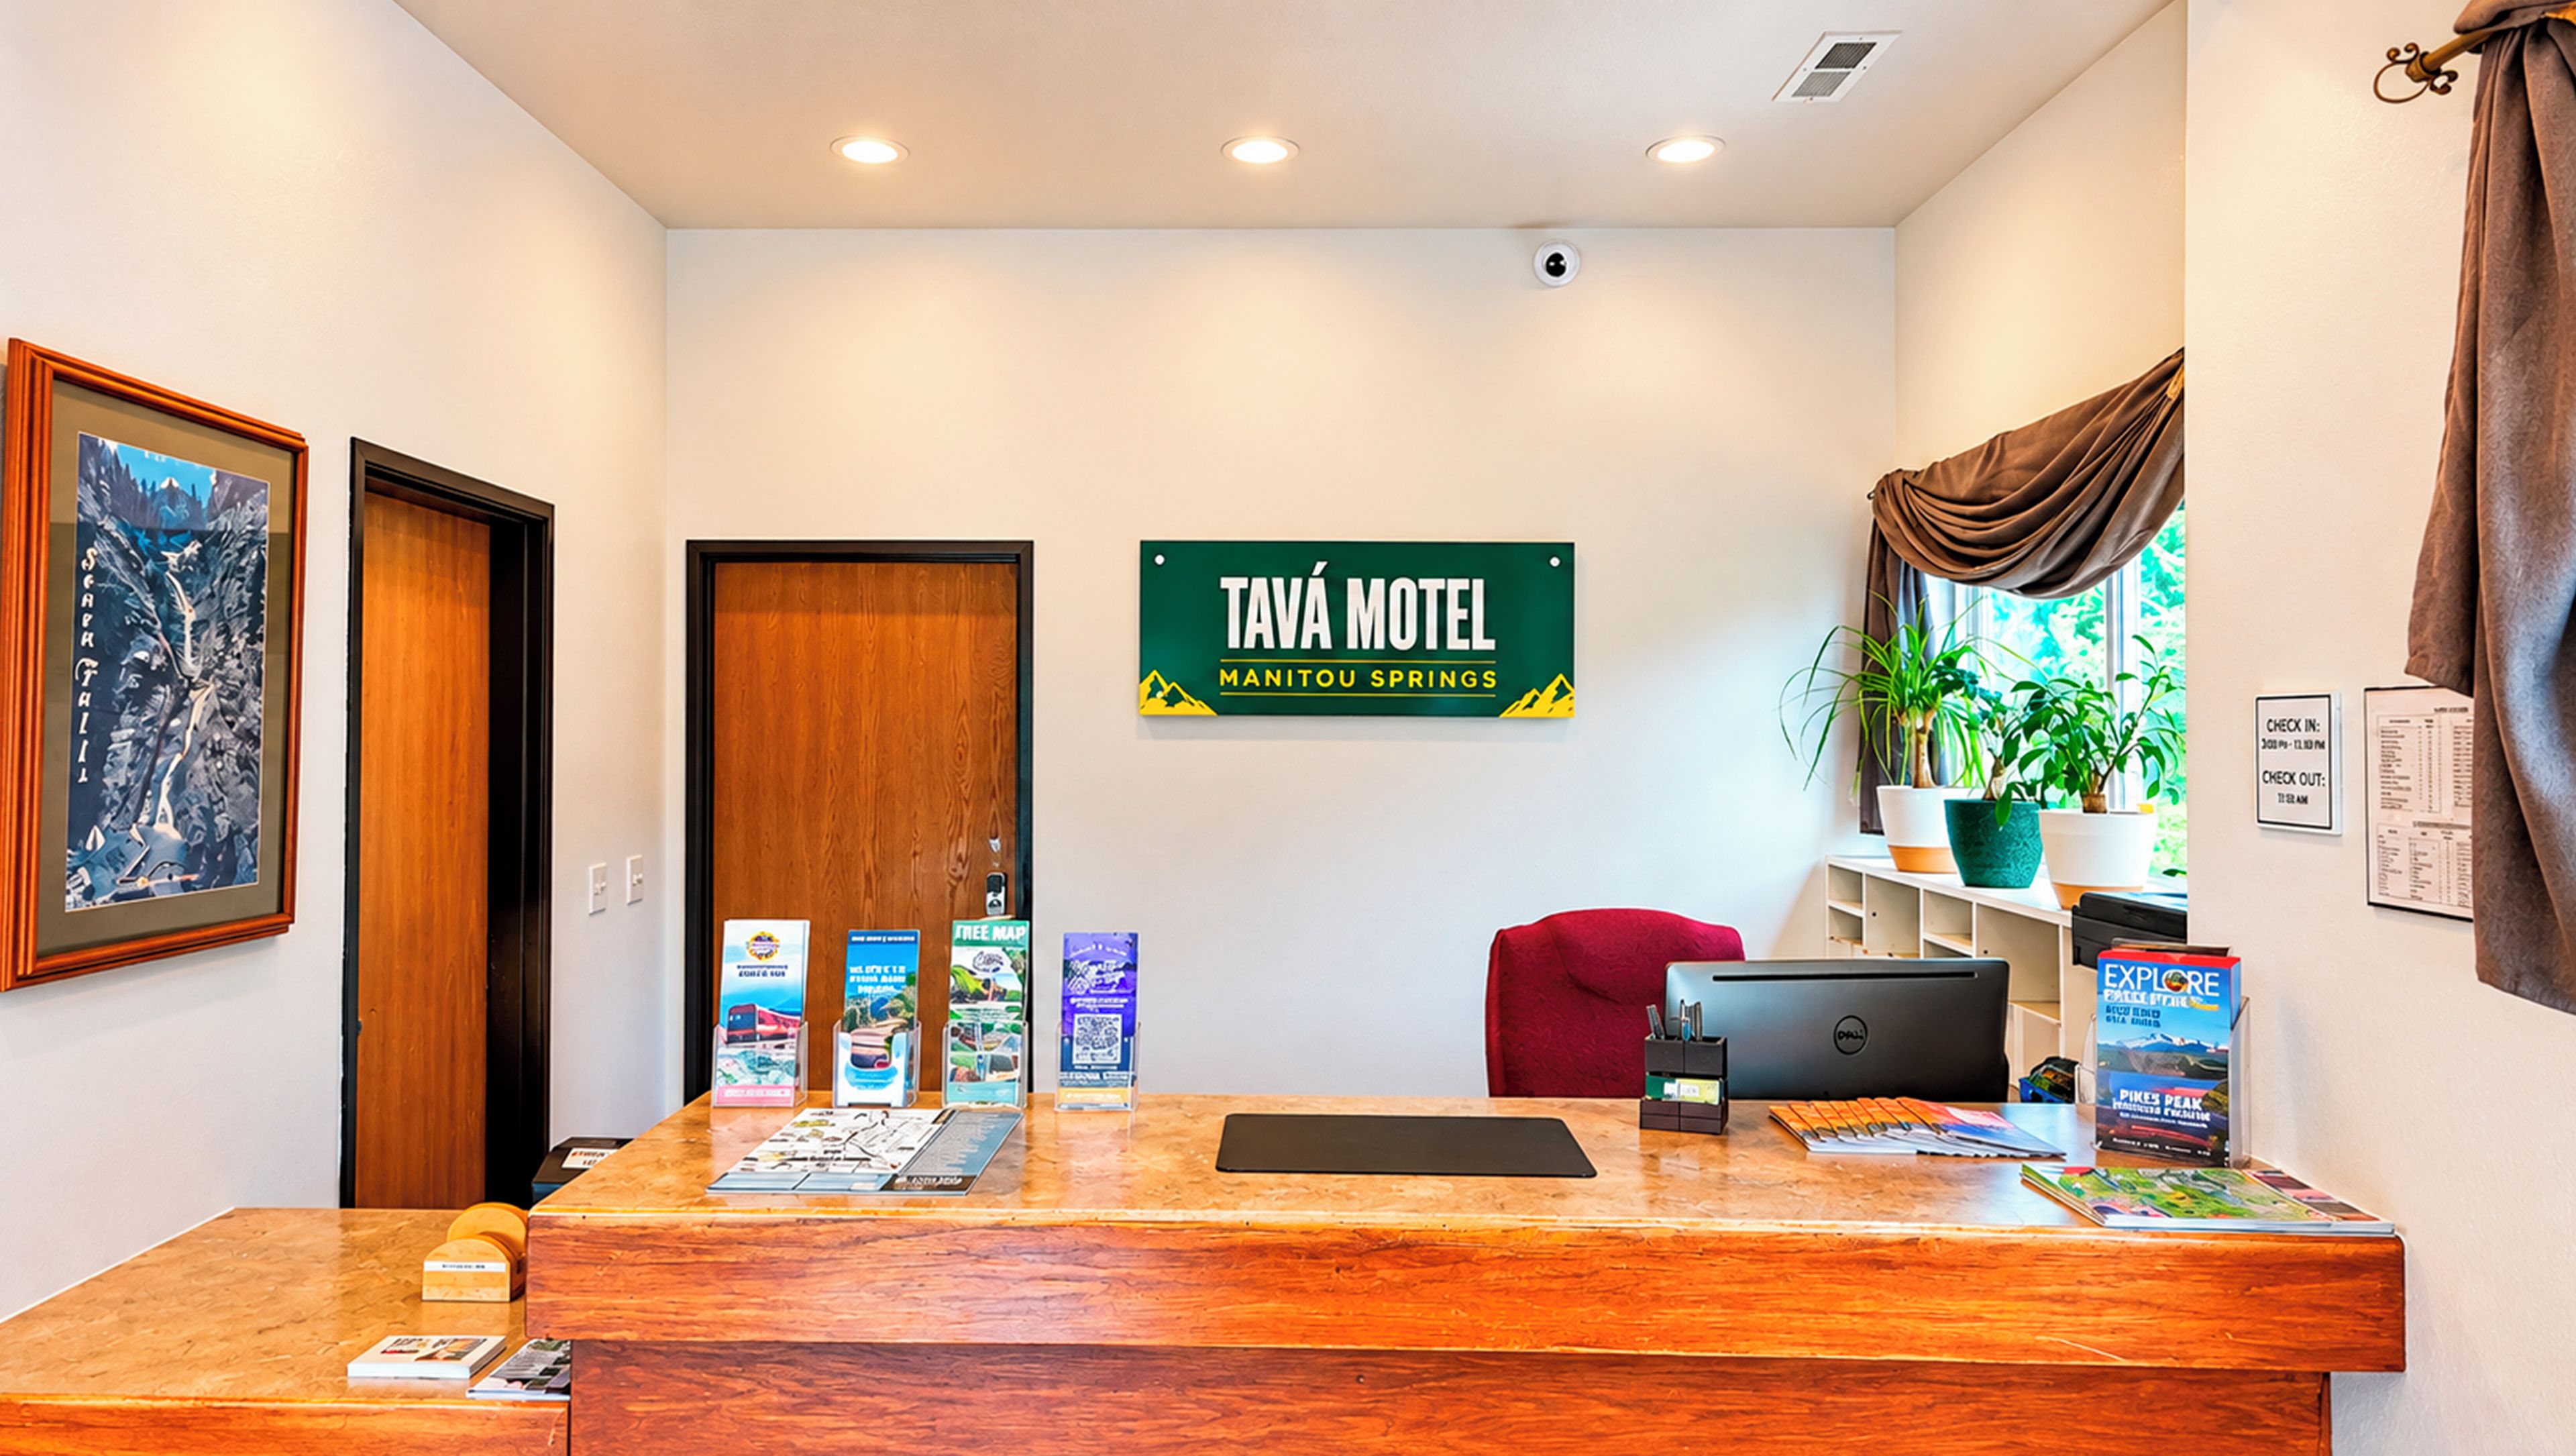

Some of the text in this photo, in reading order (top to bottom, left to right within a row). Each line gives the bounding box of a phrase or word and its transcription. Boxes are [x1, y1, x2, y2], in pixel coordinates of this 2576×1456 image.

[1220, 561, 1496, 651] TAVÁ MOTEL
[1220, 668, 1497, 688] MANITOU SPRINGS
[2266, 718, 2320, 733] CHECK IN:
[2261, 770, 2326, 787] CHECK OUT:
[992, 925, 1026, 941] MAP
[2104, 963, 2220, 998] EXPLORE
[2164, 1094, 2203, 1111] PEAK
